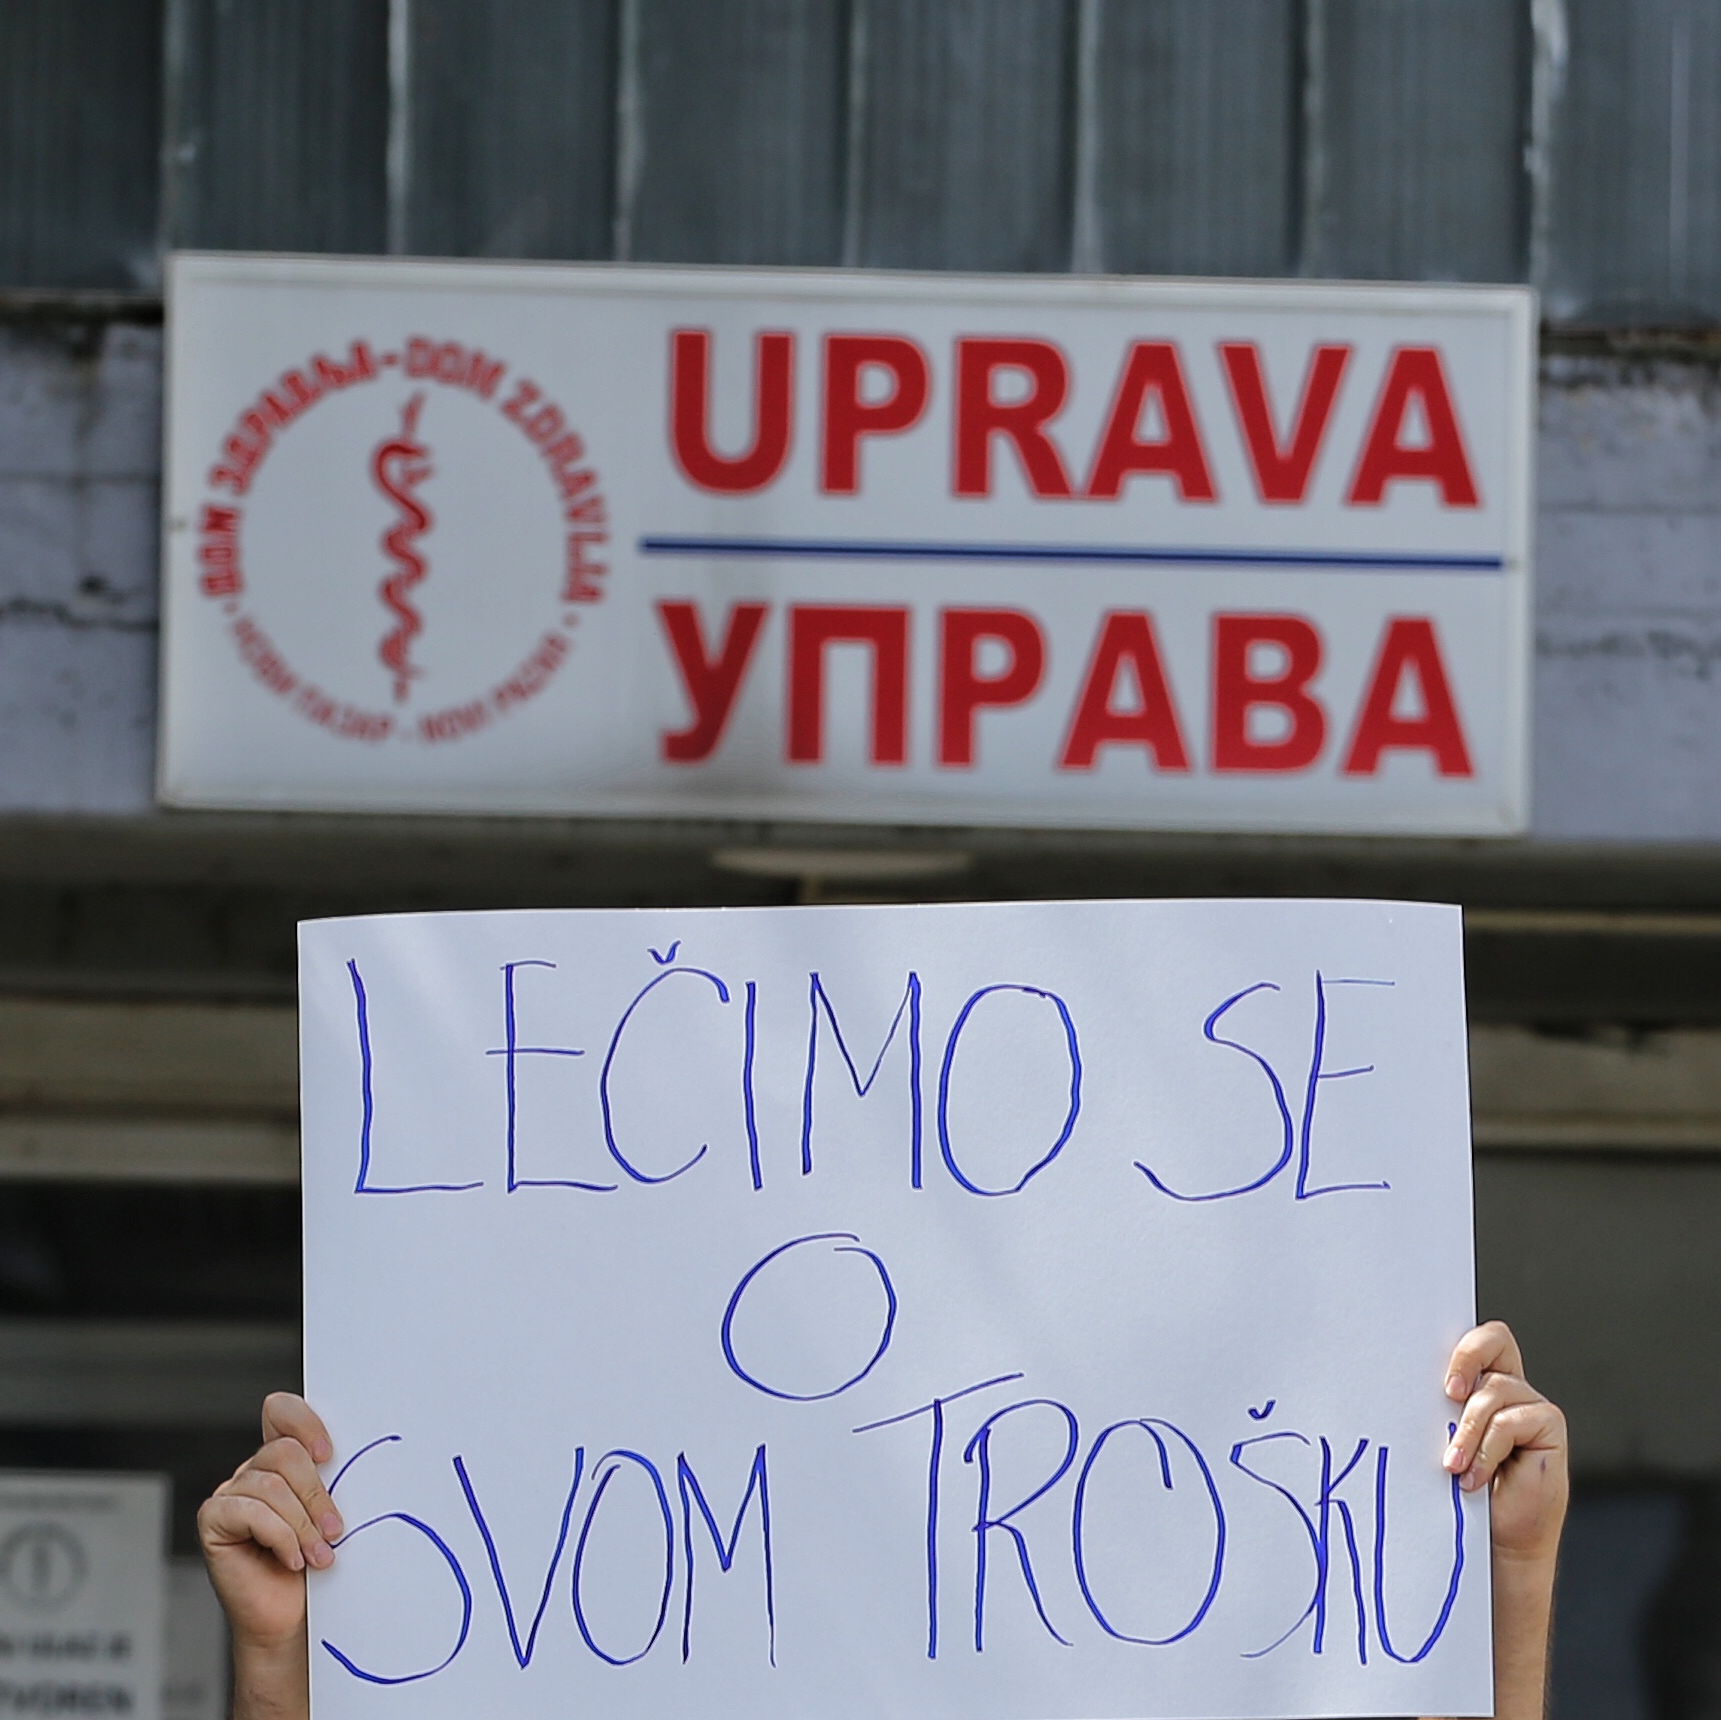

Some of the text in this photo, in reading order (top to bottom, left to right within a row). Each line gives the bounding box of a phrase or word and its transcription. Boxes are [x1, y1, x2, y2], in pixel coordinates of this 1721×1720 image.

[666, 327, 1484, 511] UPRAVA
[654, 598, 1478, 781] УПРАВА
[344, 941, 1396, 1202] LEČIMO SE
[720, 1233, 897, 1401] O
[322, 1373, 1466, 1685] SVOM TROŠKU
